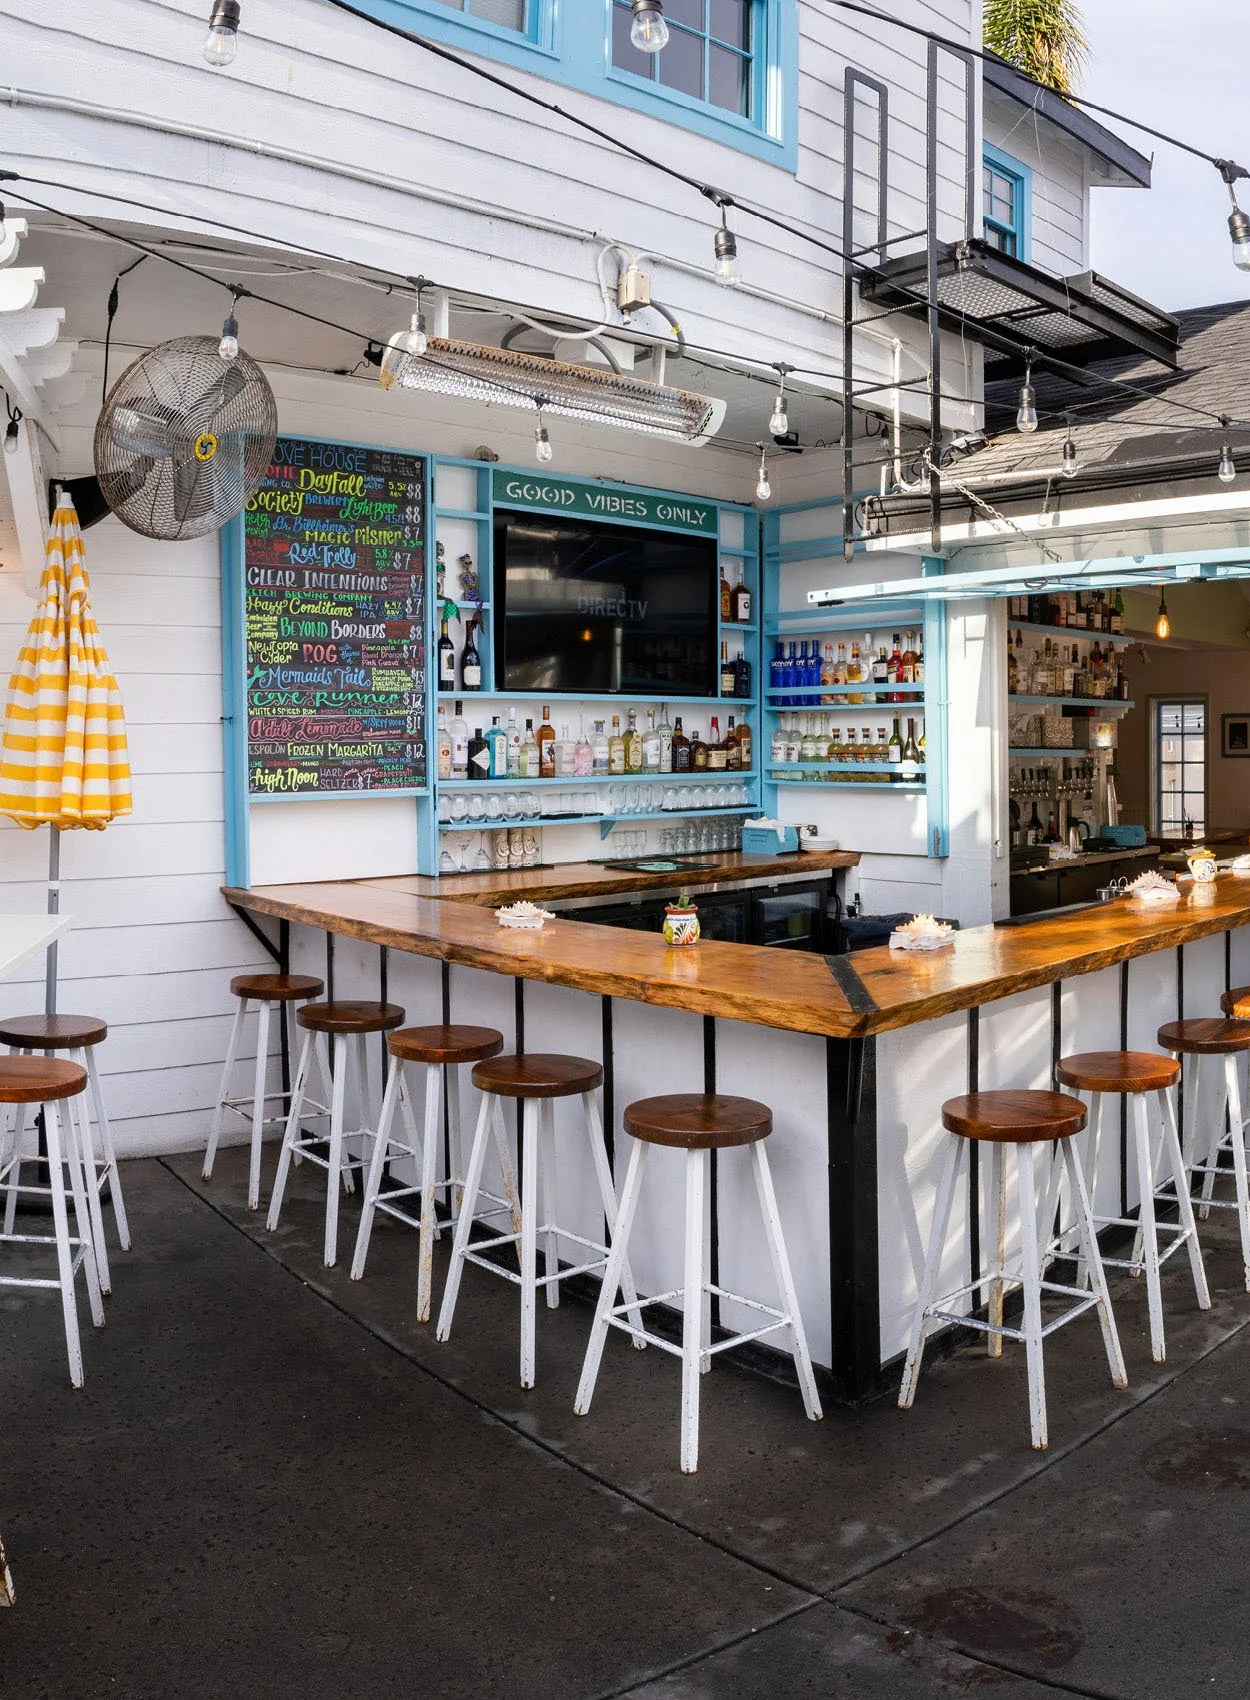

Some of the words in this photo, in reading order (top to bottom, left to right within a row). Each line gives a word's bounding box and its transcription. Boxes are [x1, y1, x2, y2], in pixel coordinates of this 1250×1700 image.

[264, 445, 304, 466] OVE
[310, 448, 367, 473] HOUSE
[407, 483, 421, 500] $8
[305, 493, 347, 506] BREWERY
[406, 505, 420, 523] $8
[506, 481, 576, 505] GOOD
[586, 493, 648, 517] VIBES
[656, 504, 707, 526] ONLY
[354, 526, 402, 546] Pilsner
[404, 525, 420, 541] $7
[285, 543, 320, 565] Red
[375, 548, 393, 559] 5.8%
[393, 551, 411, 570] $7
[247, 566, 298, 588] CLEAR
[410, 574, 422, 590] $7
[289, 597, 354, 618] Conditions
[355, 602, 379, 610] HAZY
[406, 597, 422, 614] $7
[333, 592, 373, 602] COMPANY
[576, 594, 649, 619] DIRECTV
[360, 610, 376, 618] IPA
[280, 617, 329, 638] BEYOND
[331, 619, 386, 639] BORDERS
[409, 625, 423, 640] $8
[248, 641, 299, 654] Newtopia
[260, 650, 292, 664] Cyder
[403, 644, 417, 658] $7
[259, 665, 333, 690] Mermaids
[334, 666, 371, 690] Tail
[253, 691, 307, 706] Cove
[315, 691, 400, 707] Runner
[403, 692, 424, 708] $12
[406, 715, 421, 729] $11
[287, 742, 324, 756] FROZEN
[404, 744, 425, 758] $12
[320, 768, 343, 777] HARD
